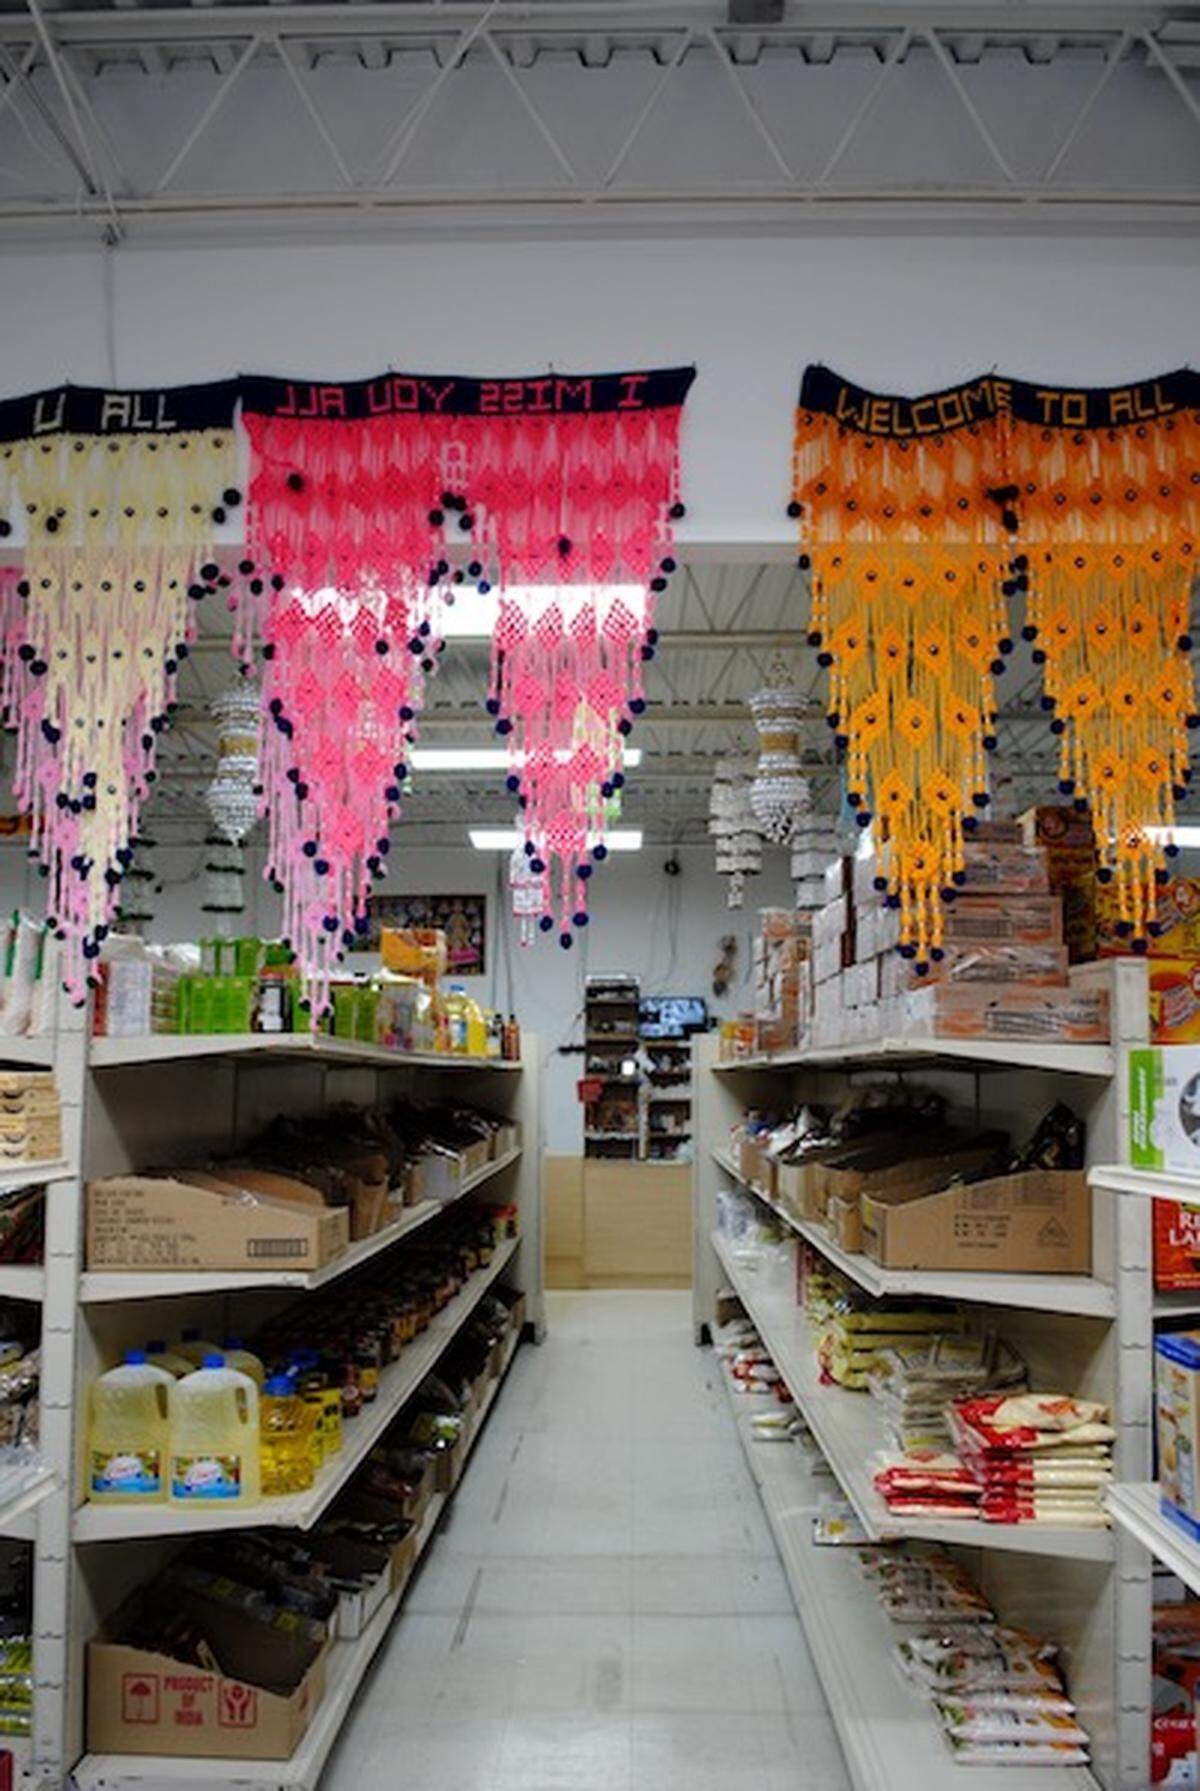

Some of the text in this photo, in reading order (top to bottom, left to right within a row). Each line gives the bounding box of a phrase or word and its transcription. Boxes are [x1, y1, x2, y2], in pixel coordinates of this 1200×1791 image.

[33, 392, 178, 434] U ALL
[836, 380, 1175, 436] WELCOME TO ALL
[164, 1675, 214, 1693] PRODUCT
[175, 1710, 204, 1726] INDIA
